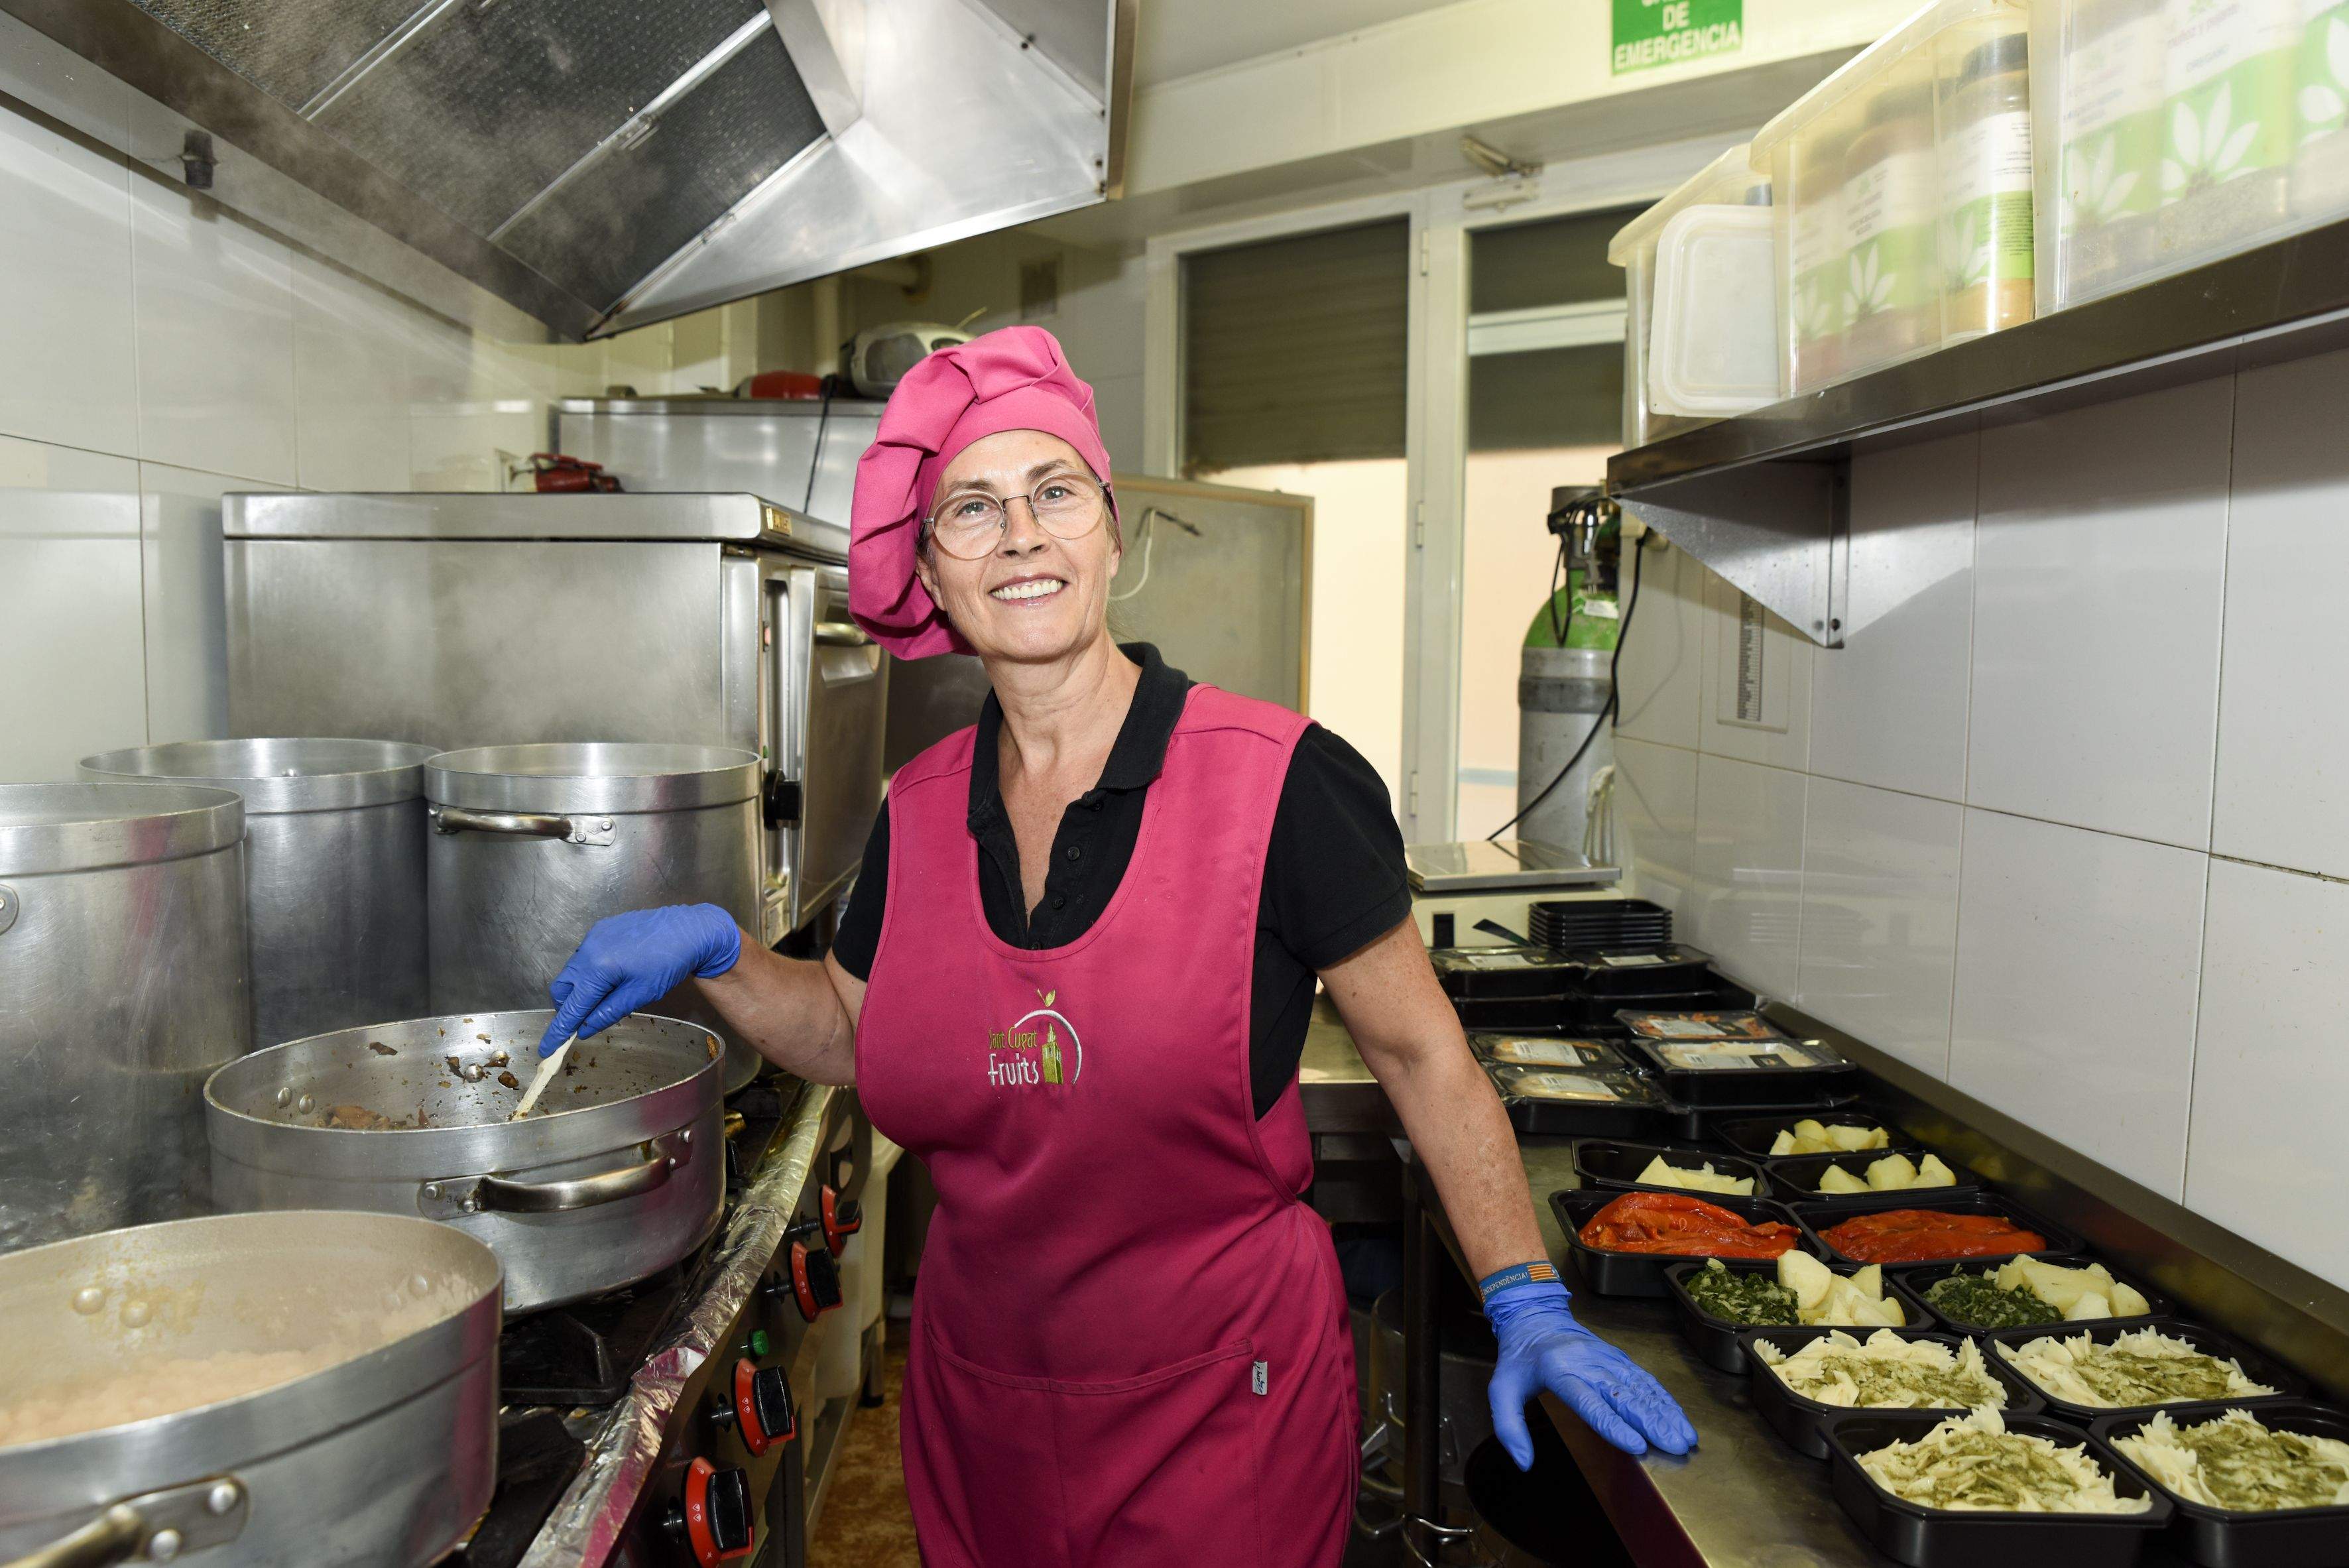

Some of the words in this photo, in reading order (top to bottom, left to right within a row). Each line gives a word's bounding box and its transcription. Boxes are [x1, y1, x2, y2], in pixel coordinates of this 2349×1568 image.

[1662, 1, 1689, 31] DE
[1614, 20, 1741, 70] EMERGENCIA
[1008, 1026, 1038, 1053] Cugat
